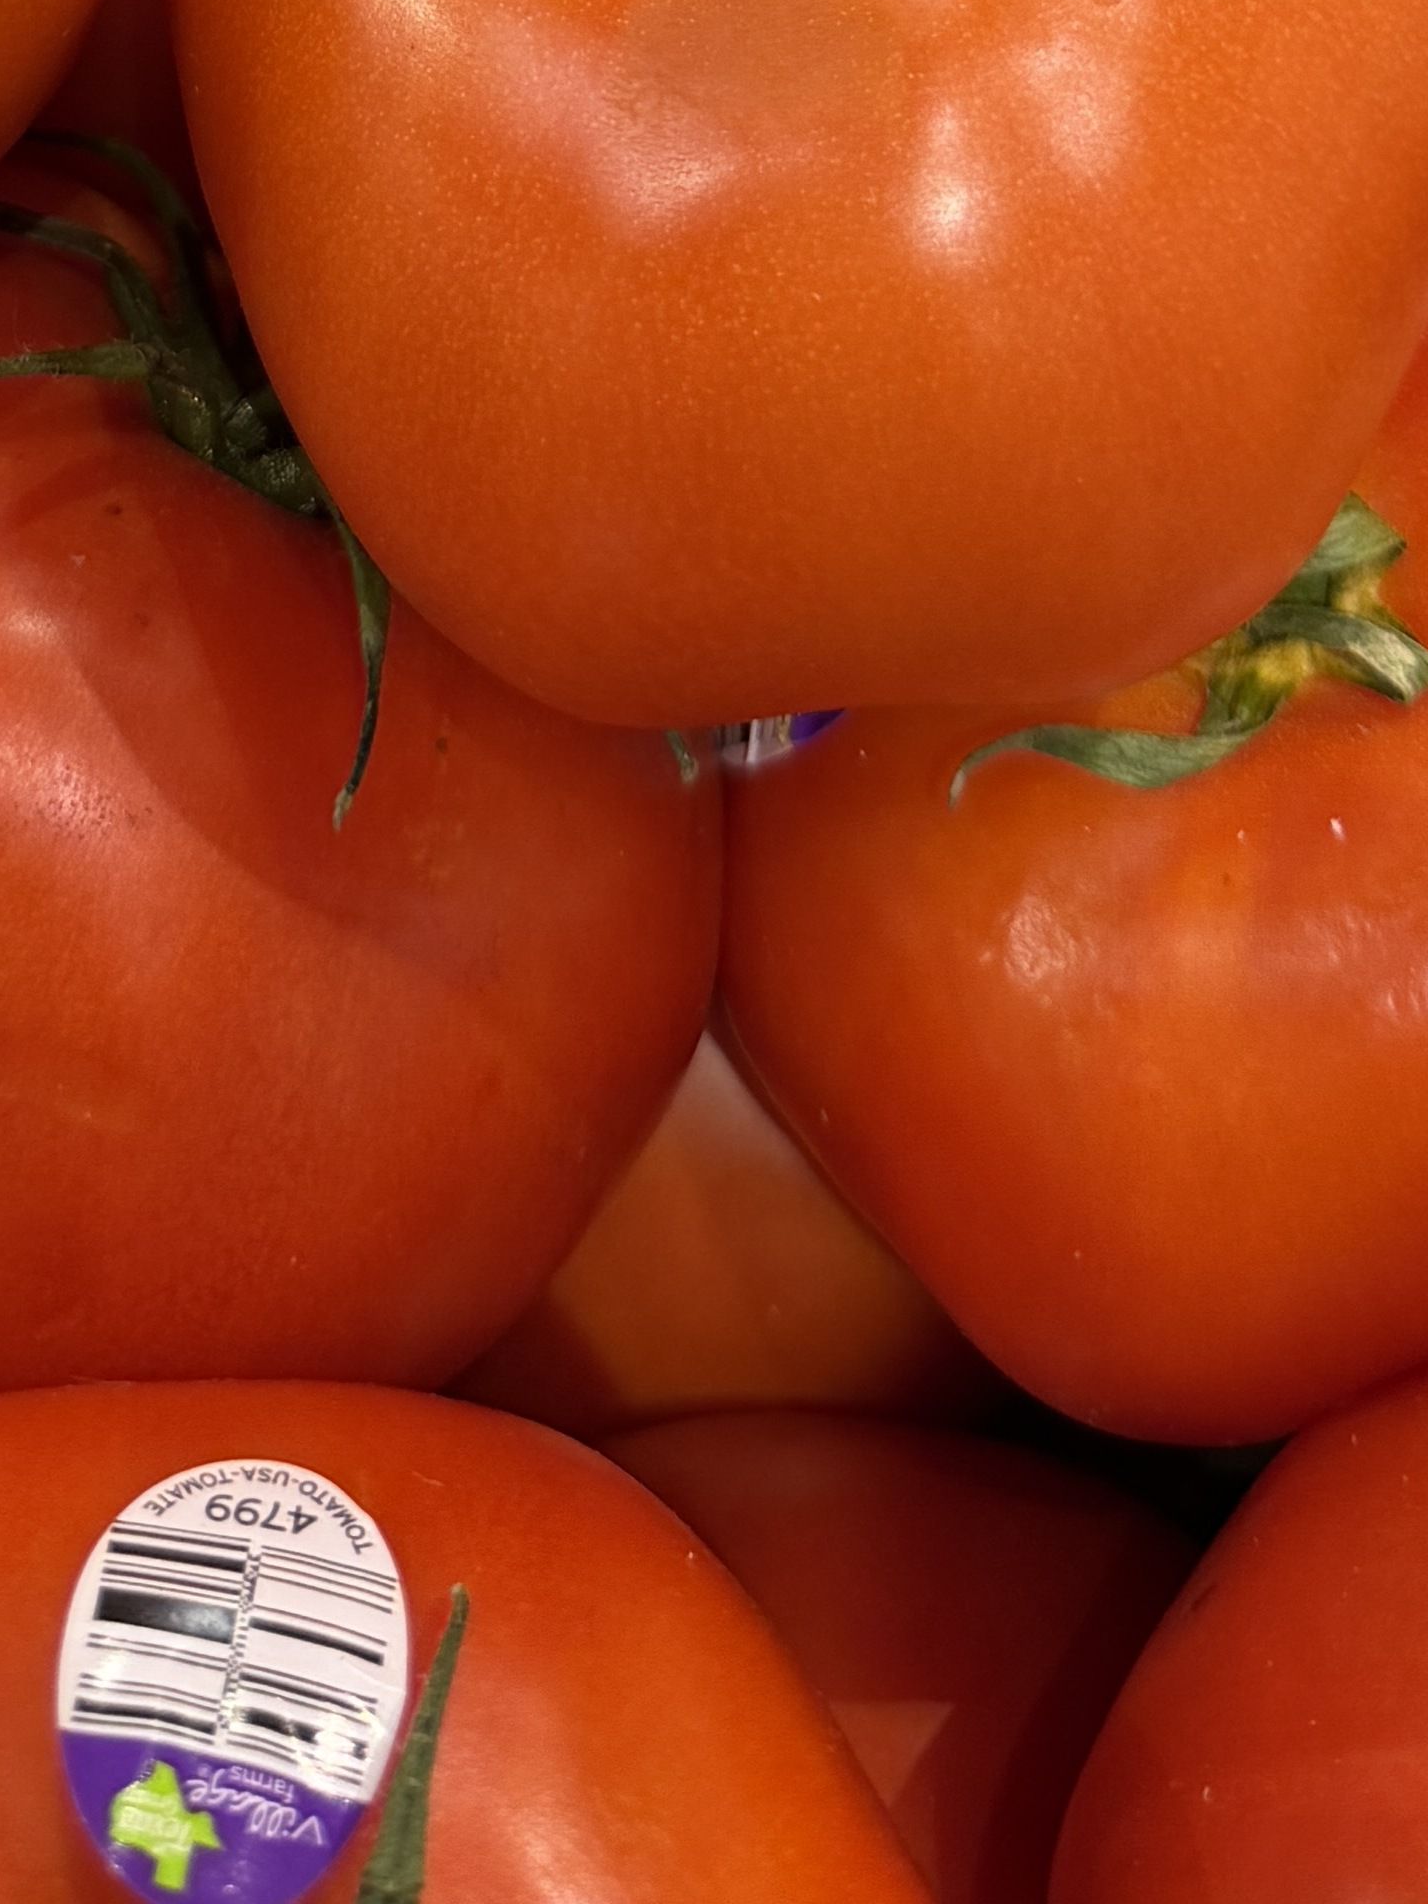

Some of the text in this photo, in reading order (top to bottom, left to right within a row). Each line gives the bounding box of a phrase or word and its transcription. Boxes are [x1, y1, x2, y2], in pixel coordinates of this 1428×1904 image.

[143, 1465, 373, 1555] TOMATO-USA-TOMATE
[205, 1494, 318, 1535] 4799
[186, 1768, 324, 1847] Village
[228, 1765, 295, 1805] farms
